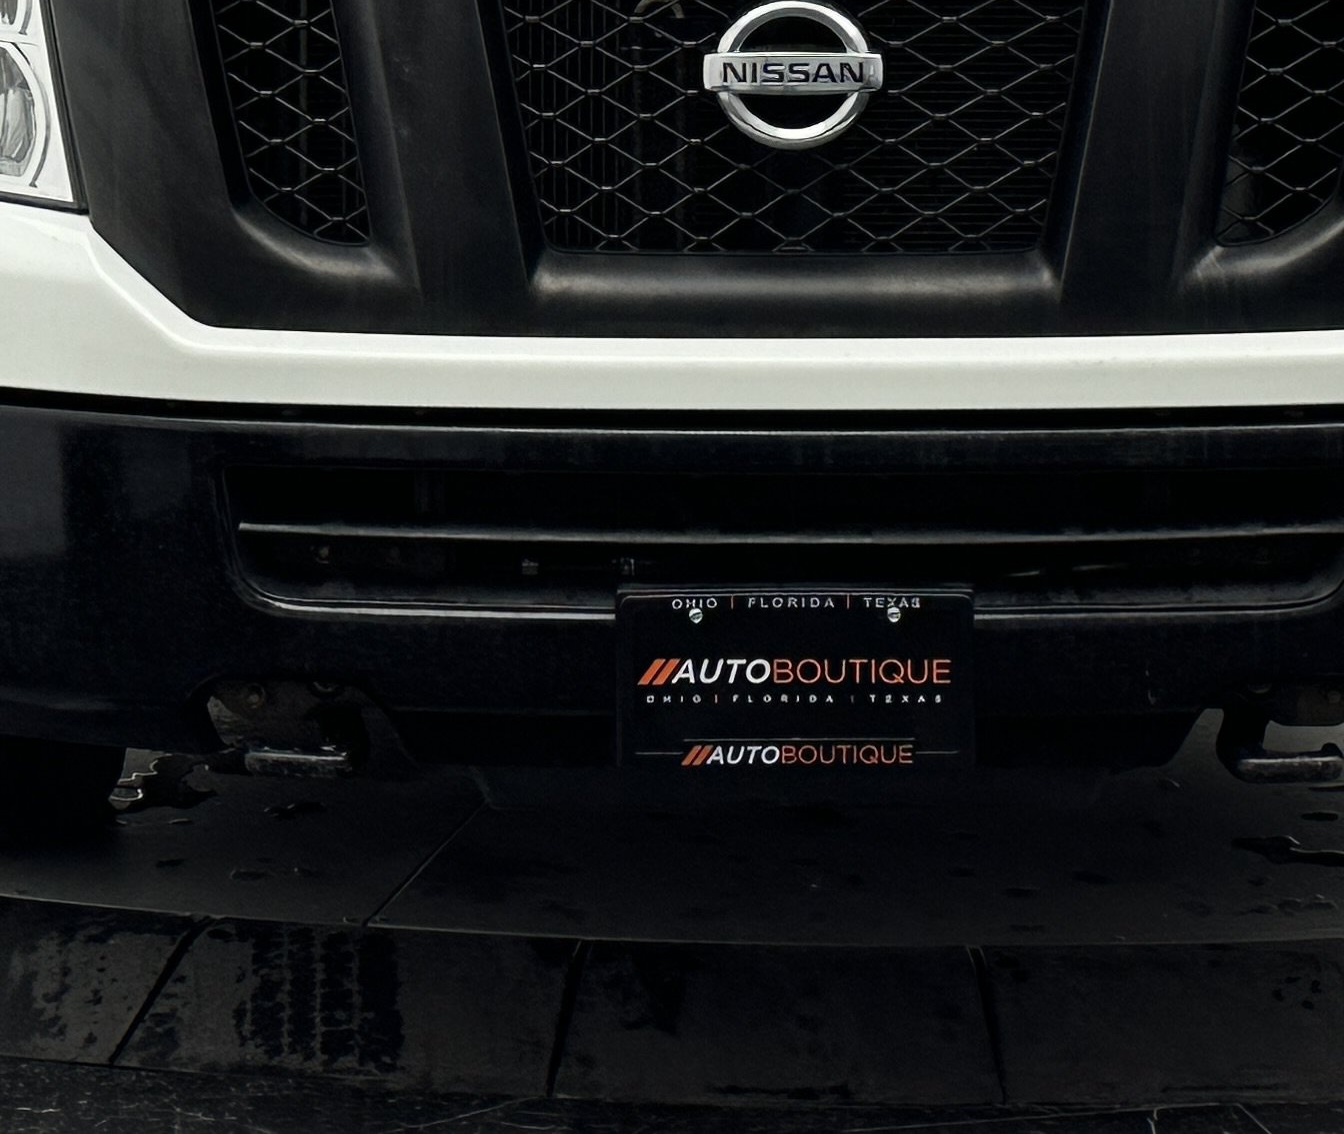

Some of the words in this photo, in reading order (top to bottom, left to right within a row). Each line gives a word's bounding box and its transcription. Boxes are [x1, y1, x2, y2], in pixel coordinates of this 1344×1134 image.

[722, 61, 864, 84] NISSAN
[671, 597, 718, 610] OHIO
[747, 596, 836, 609] FLORIDA
[863, 597, 921, 608] TEXAS
[671, 658, 952, 685] AUTOBOUTIQUE
[646, 695, 702, 704] OHIO
[732, 694, 834, 704] FLORIDA
[869, 694, 943, 704] TEXAS
[706, 744, 914, 765] AUTOBOUTIQUE
